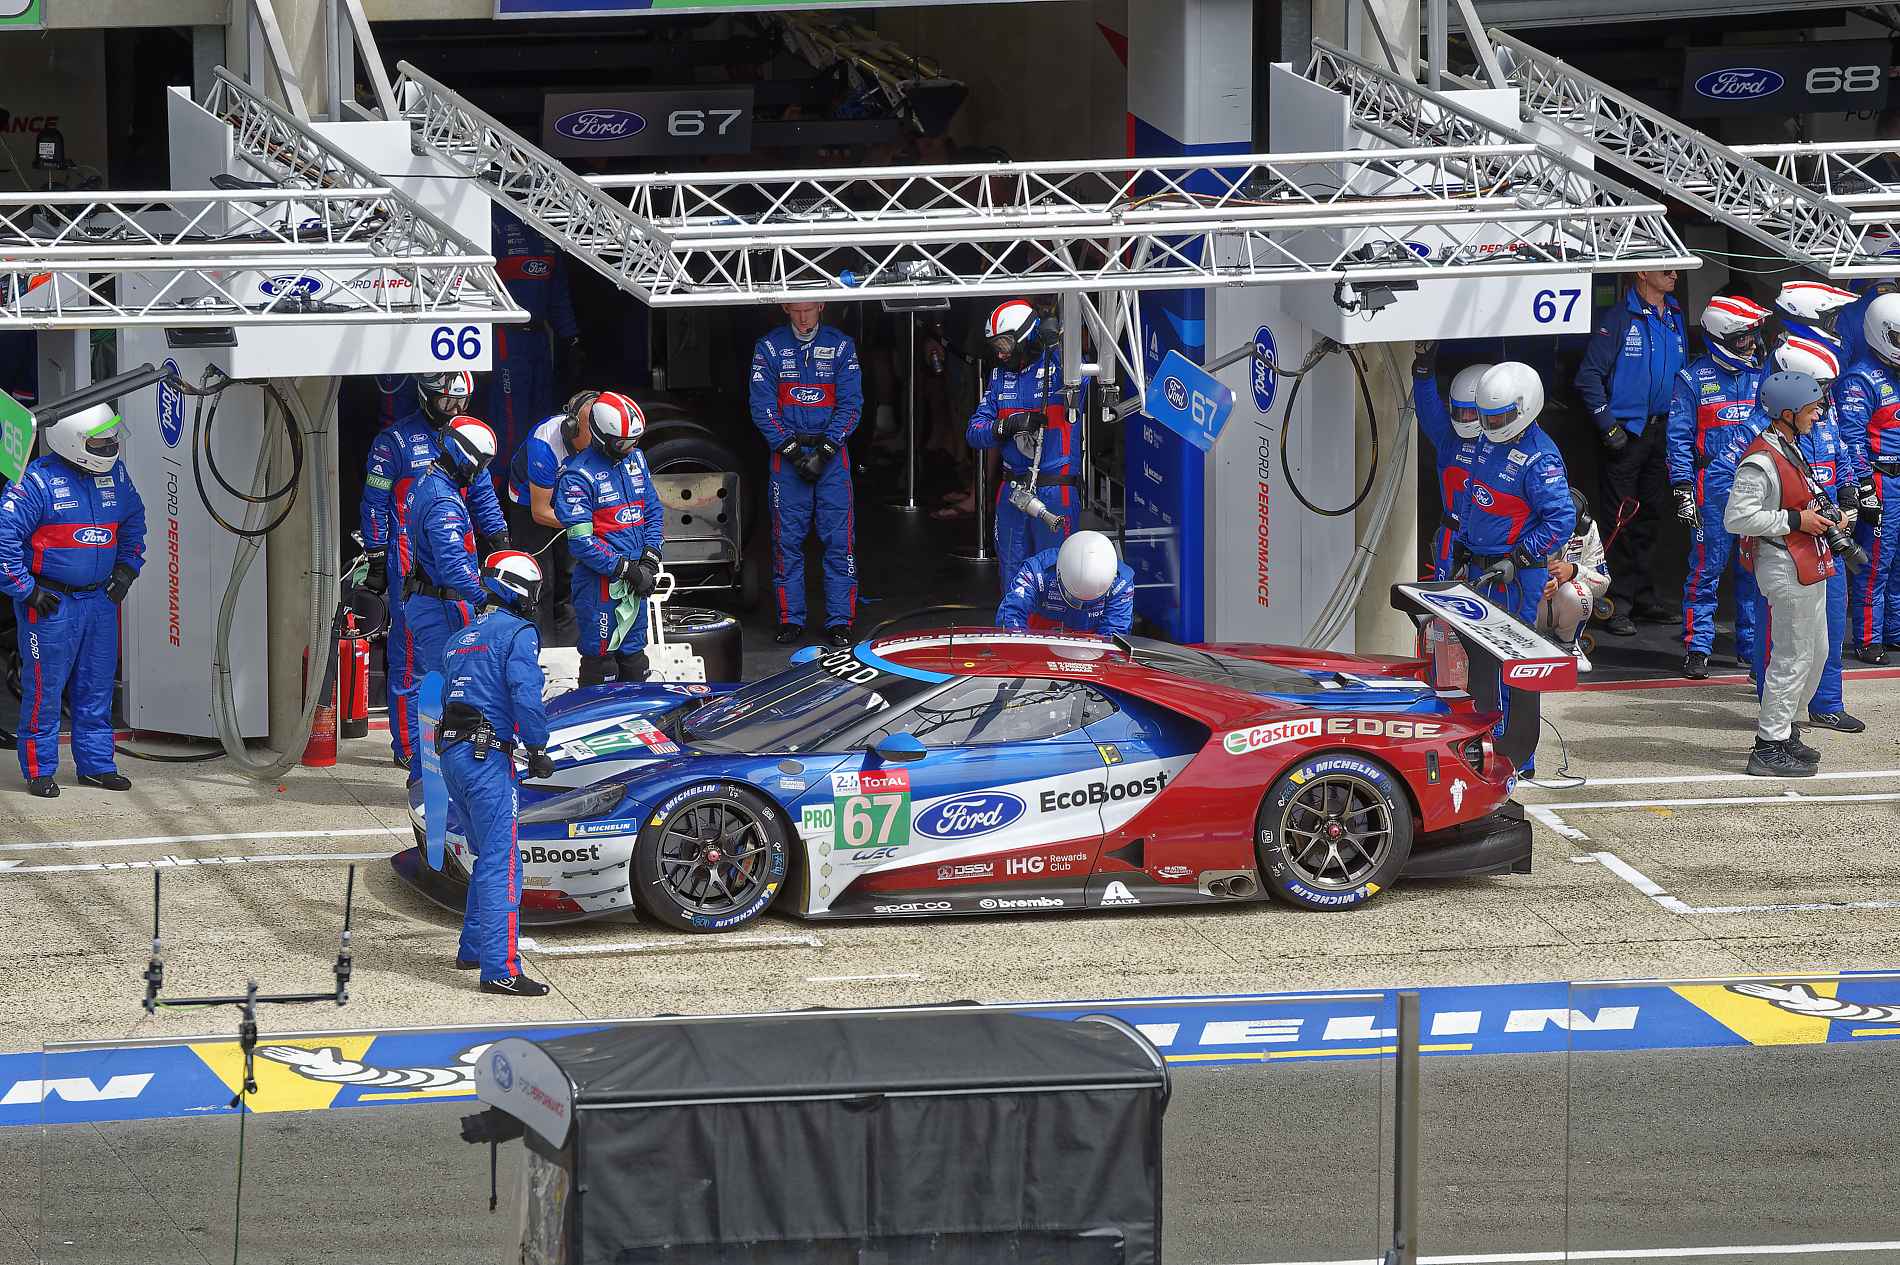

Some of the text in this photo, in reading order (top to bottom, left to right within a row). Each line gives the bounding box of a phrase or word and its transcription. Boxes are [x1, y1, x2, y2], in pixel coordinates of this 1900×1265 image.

[1805, 66, 1881, 94] 68
[667, 109, 743, 137] 67
[1532, 288, 1582, 324] 67
[430, 325, 482, 361] 66
[1191, 390, 1218, 432] 67
[1257, 436, 1270, 608] FORD PERFORMANCE
[166, 471, 180, 648] FORD PERFORMANCE
[600, 612, 609, 639] FORD
[30, 631, 40, 660] FORD
[821, 647, 880, 684] FORD
[1509, 662, 1570, 678] GT
[1249, 718, 1441, 748] Castrol EDGE
[861, 776, 907, 788] TOTAL
[1315, 759, 1380, 780] MICHELIN
[511, 787, 519, 818] FORD
[665, 784, 717, 812] MICHELIN
[1039, 770, 1169, 813] EcoBoost
[587, 823, 631, 833] MICHELIN
[803, 794, 903, 847] PRO 67
[520, 844, 600, 864] oBoost
[1006, 851, 1087, 875] IHG Rewards
[1050, 862, 1071, 872] Club
[873, 896, 1065, 914] sparco brembo
[1100, 898, 1141, 906] AXALTA
[1289, 884, 1355, 905] MICHELIN
[714, 898, 765, 929] MICHELIN
